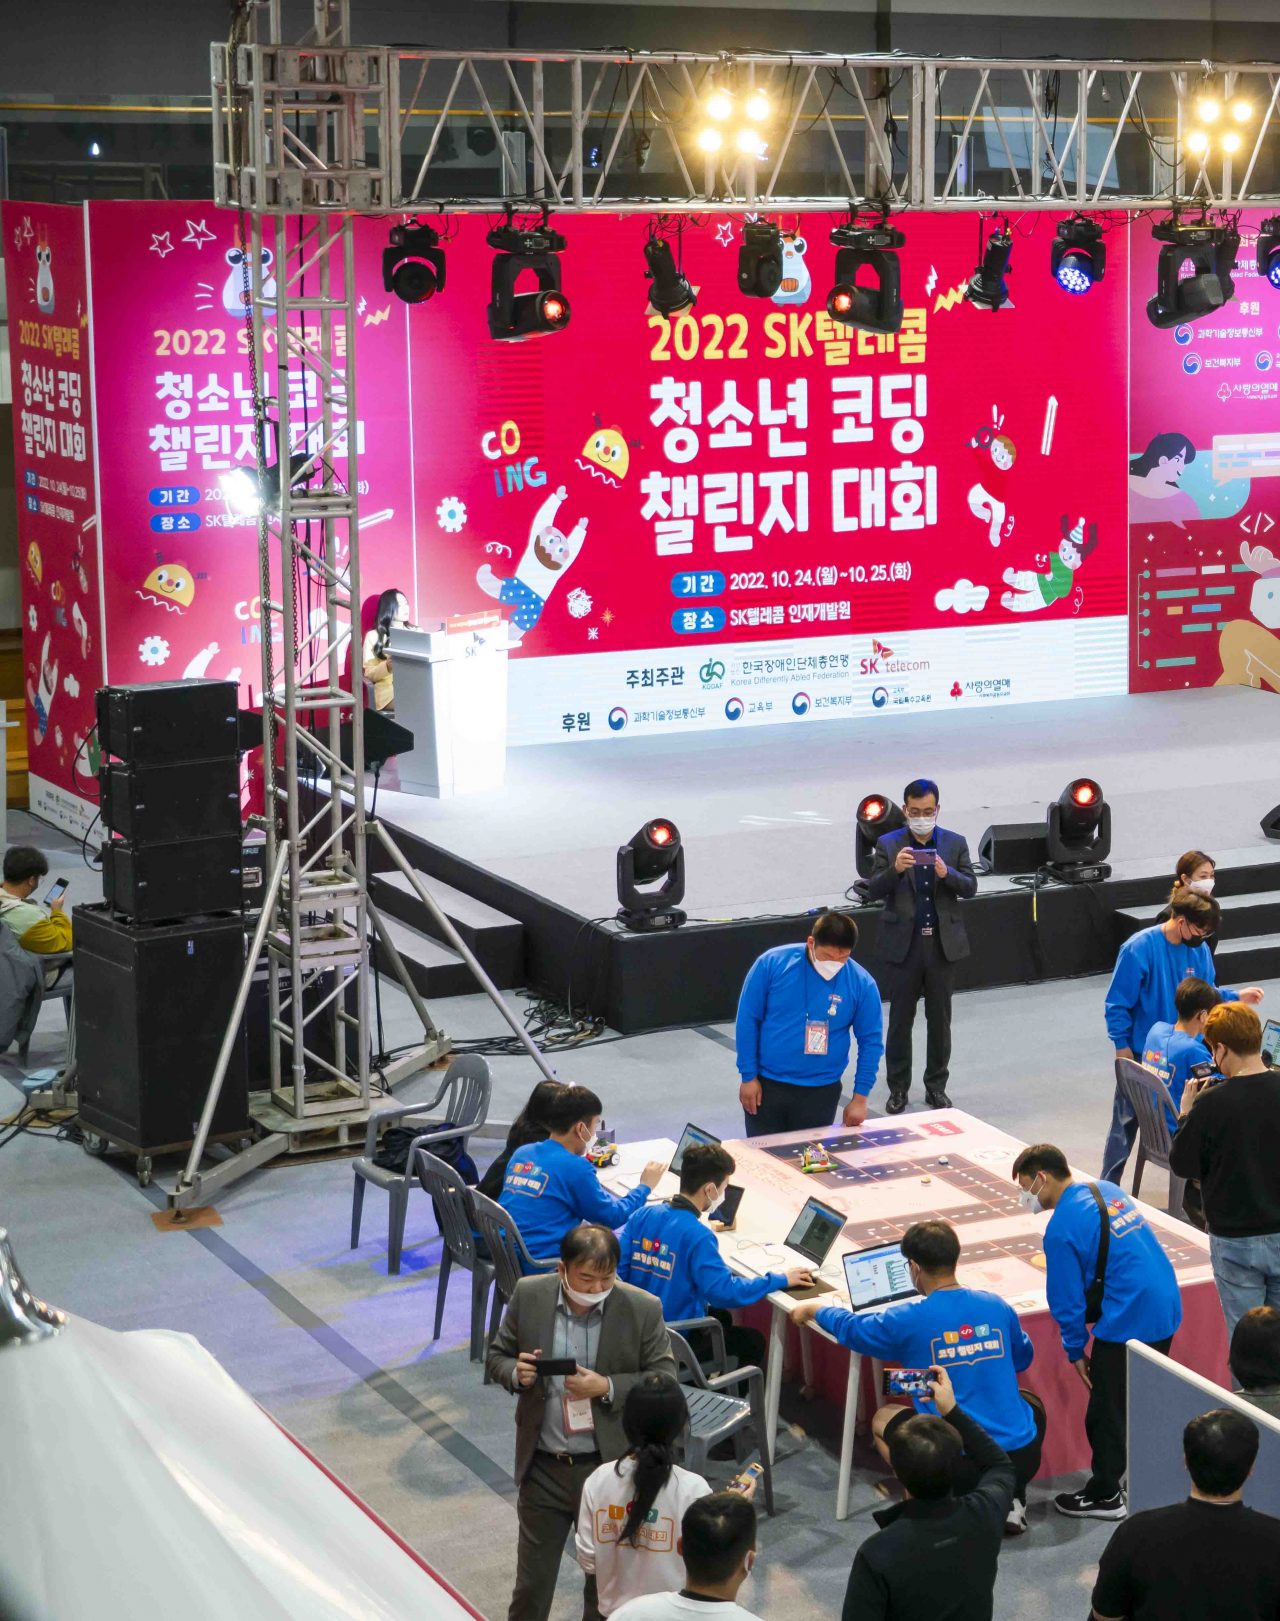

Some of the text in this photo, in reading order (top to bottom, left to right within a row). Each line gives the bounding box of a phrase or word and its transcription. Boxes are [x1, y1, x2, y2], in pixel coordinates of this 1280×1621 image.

[1239, 302, 1260, 315] 후원
[20, 320, 80, 360] 2022 SK텔레콤
[153, 328, 226, 355] 2022
[648, 313, 749, 361] 2022
[1198, 327, 1263, 339] 과학기술정보통신부
[21, 359, 82, 419] 청소년 코딩
[155, 371, 270, 420] 청소년
[1233, 382, 1279, 394] 사랑의열매
[649, 374, 928, 463] 청소년 코딩
[21, 408, 87, 462] 챌린지 대회
[149, 424, 271, 472] 챌린지
[494, 456, 547, 497] ING
[160, 489, 190, 504] 기간
[640, 460, 938, 556] 챌린지 대회
[161, 517, 191, 530] 장소
[682, 574, 714, 594] 기간
[682, 600, 852, 630] 장소 SK텔레콤 인재개발원
[742, 654, 849, 675] 한국장애인단체총연맹
[860, 658, 930, 675] SK telecom
[626, 666, 685, 689] 주최주관
[730, 677, 752, 687] Korea
[753, 673, 789, 685] Differently
[812, 671, 849, 680] Federation
[965, 678, 1011, 693] 사랑의열매
[562, 695, 852, 733] 후원 과학기술정보통신부 교육부 보건복지부
[938, 1347, 955, 1359] 코딩
[957, 1342, 983, 1356] 챌린지
